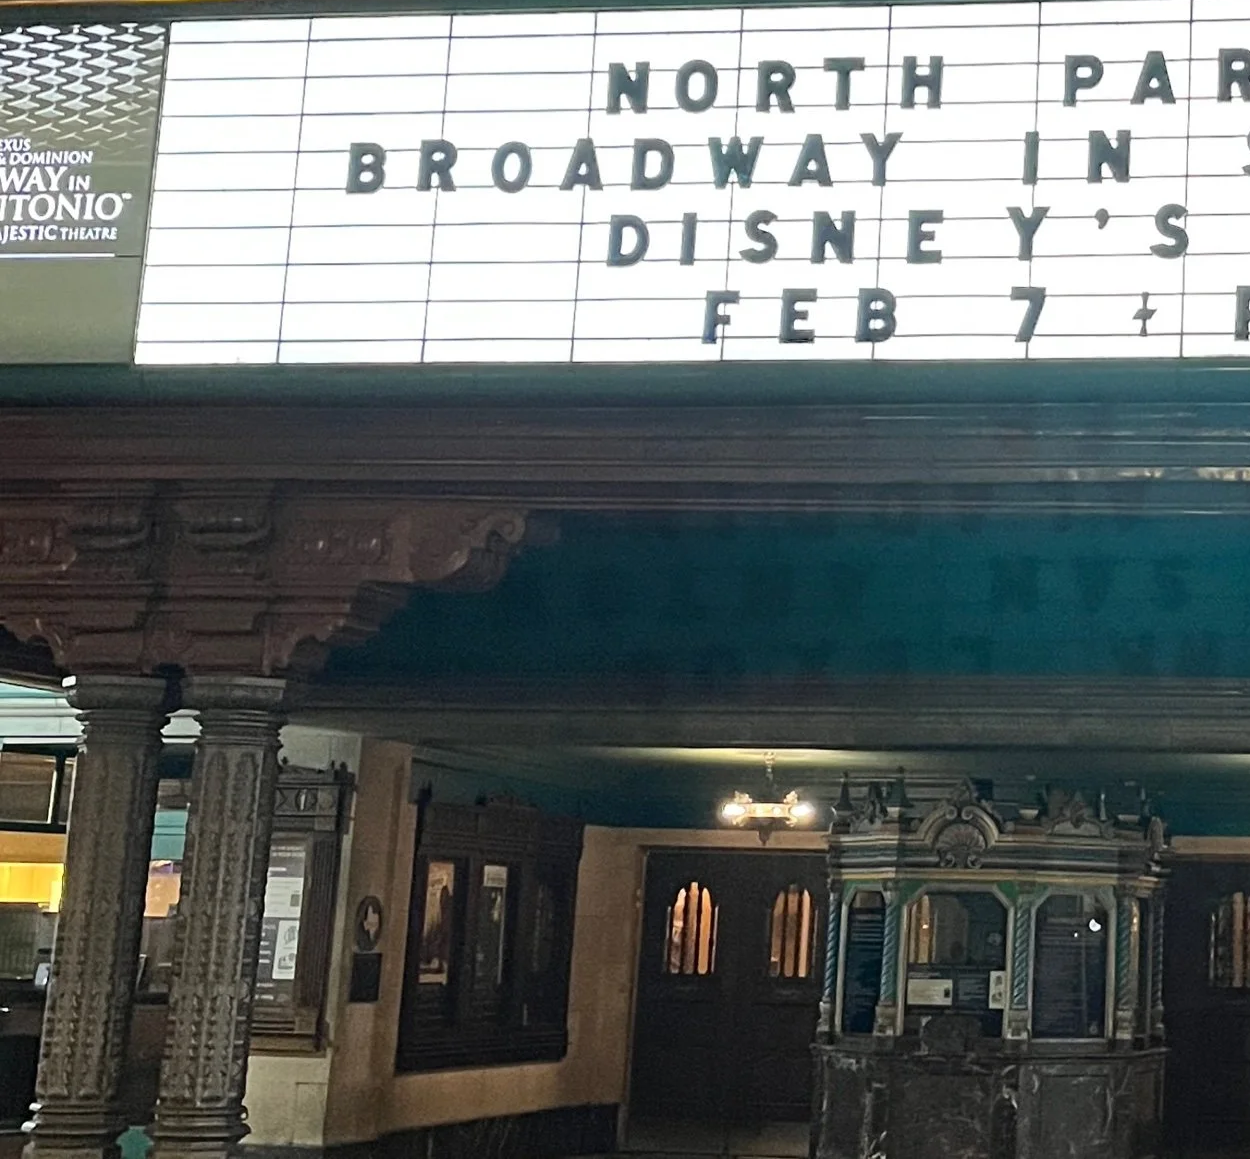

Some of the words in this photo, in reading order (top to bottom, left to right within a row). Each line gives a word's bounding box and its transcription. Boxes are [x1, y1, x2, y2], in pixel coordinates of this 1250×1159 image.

[606, 56, 943, 114] NORTH
[9, 150, 93, 165] DOMINION
[68, 175, 91, 191] IN
[346, 133, 903, 194] BROADWAY
[1023, 130, 1131, 185] IN
[0, 225, 58, 244] JESTIC
[60, 227, 118, 240] THEATRE
[607, 204, 1189, 266] DISNEY'S
[702, 288, 897, 344] FEB
[1010, 286, 1046, 343] 7
